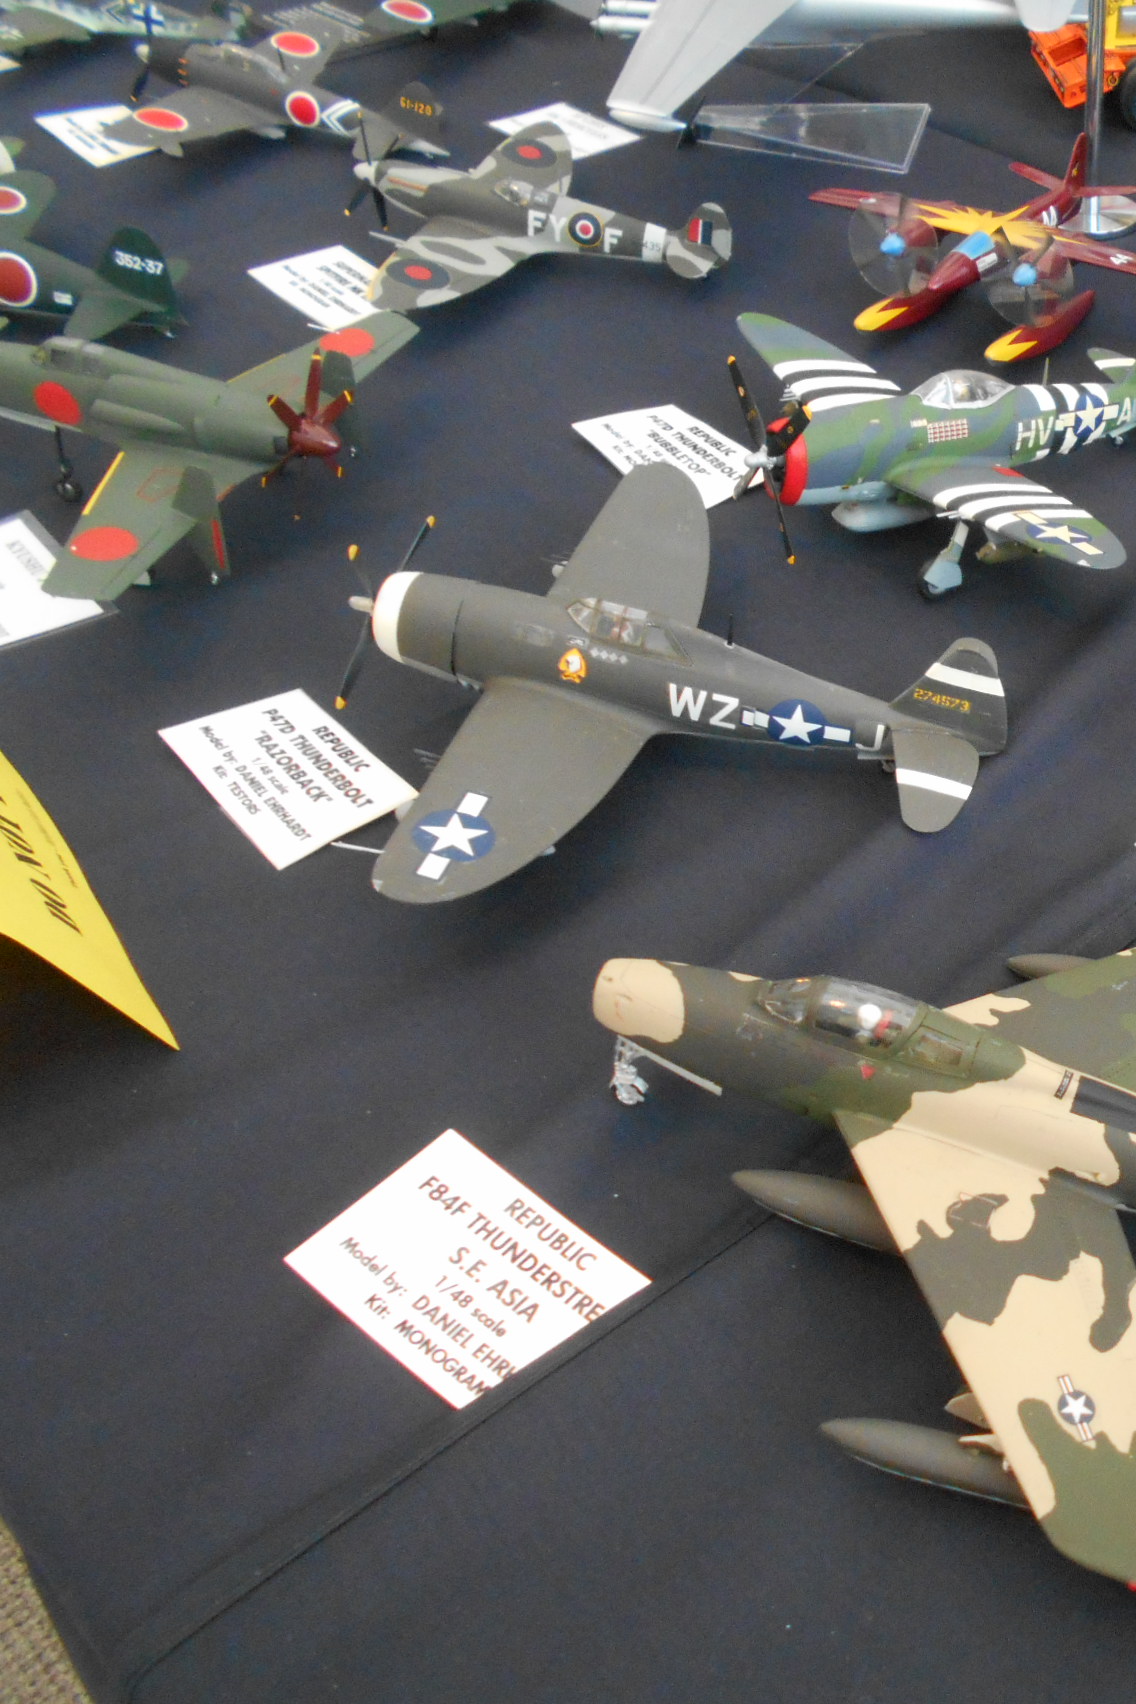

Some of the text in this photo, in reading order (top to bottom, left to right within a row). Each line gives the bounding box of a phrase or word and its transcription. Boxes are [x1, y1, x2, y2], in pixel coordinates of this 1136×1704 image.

[527, 209, 568, 243] FY
[603, 227, 623, 254] F
[1015, 416, 1054, 451] HV
[1116, 397, 1132, 426] A
[687, 425, 738, 458] REPUBLIC
[668, 682, 740, 731] WZ
[912, 688, 971, 713] 274573
[261, 707, 376, 810] P47D THUNDERBOLT
[311, 725, 371, 773] REPUBLIC
[855, 723, 886, 752] J
[199, 725, 313, 843] Model by: DANIEL EHRHARDT
[212, 764, 262, 817] Kit: TESTORS
[253, 729, 334, 804] "RAZORBACK"
[266, 771, 291, 797] scale
[418, 1175, 607, 1324] F84F THUNDERSTRE
[502, 1197, 598, 1272] REPUBLIC
[340, 1236, 388, 1278] Model
[383, 1270, 408, 1298] by:
[411, 1294, 476, 1351] DANIEL
[434, 1275, 508, 1339] 1/48 scale
[448, 1246, 541, 1325] S.E. ASIA
[364, 1293, 493, 1398] Kit: MONOGRAM
